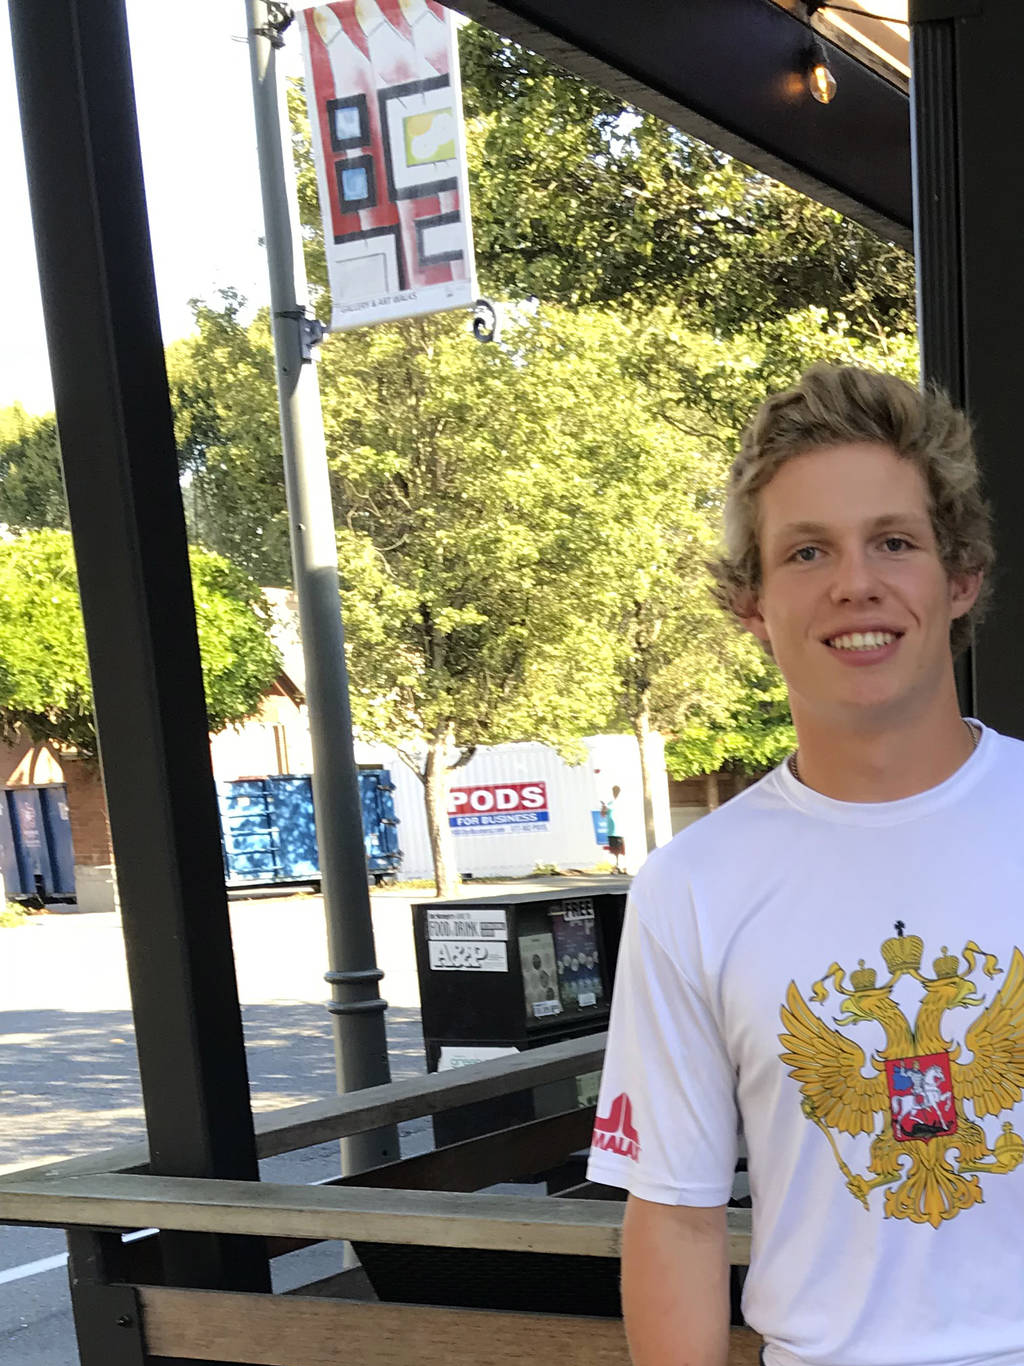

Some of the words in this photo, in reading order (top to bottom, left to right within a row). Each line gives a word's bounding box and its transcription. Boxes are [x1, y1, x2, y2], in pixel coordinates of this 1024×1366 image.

[447, 787, 545, 812] PODS
[456, 816, 480, 826] FOR
[481, 813, 538, 825] BUSINESS
